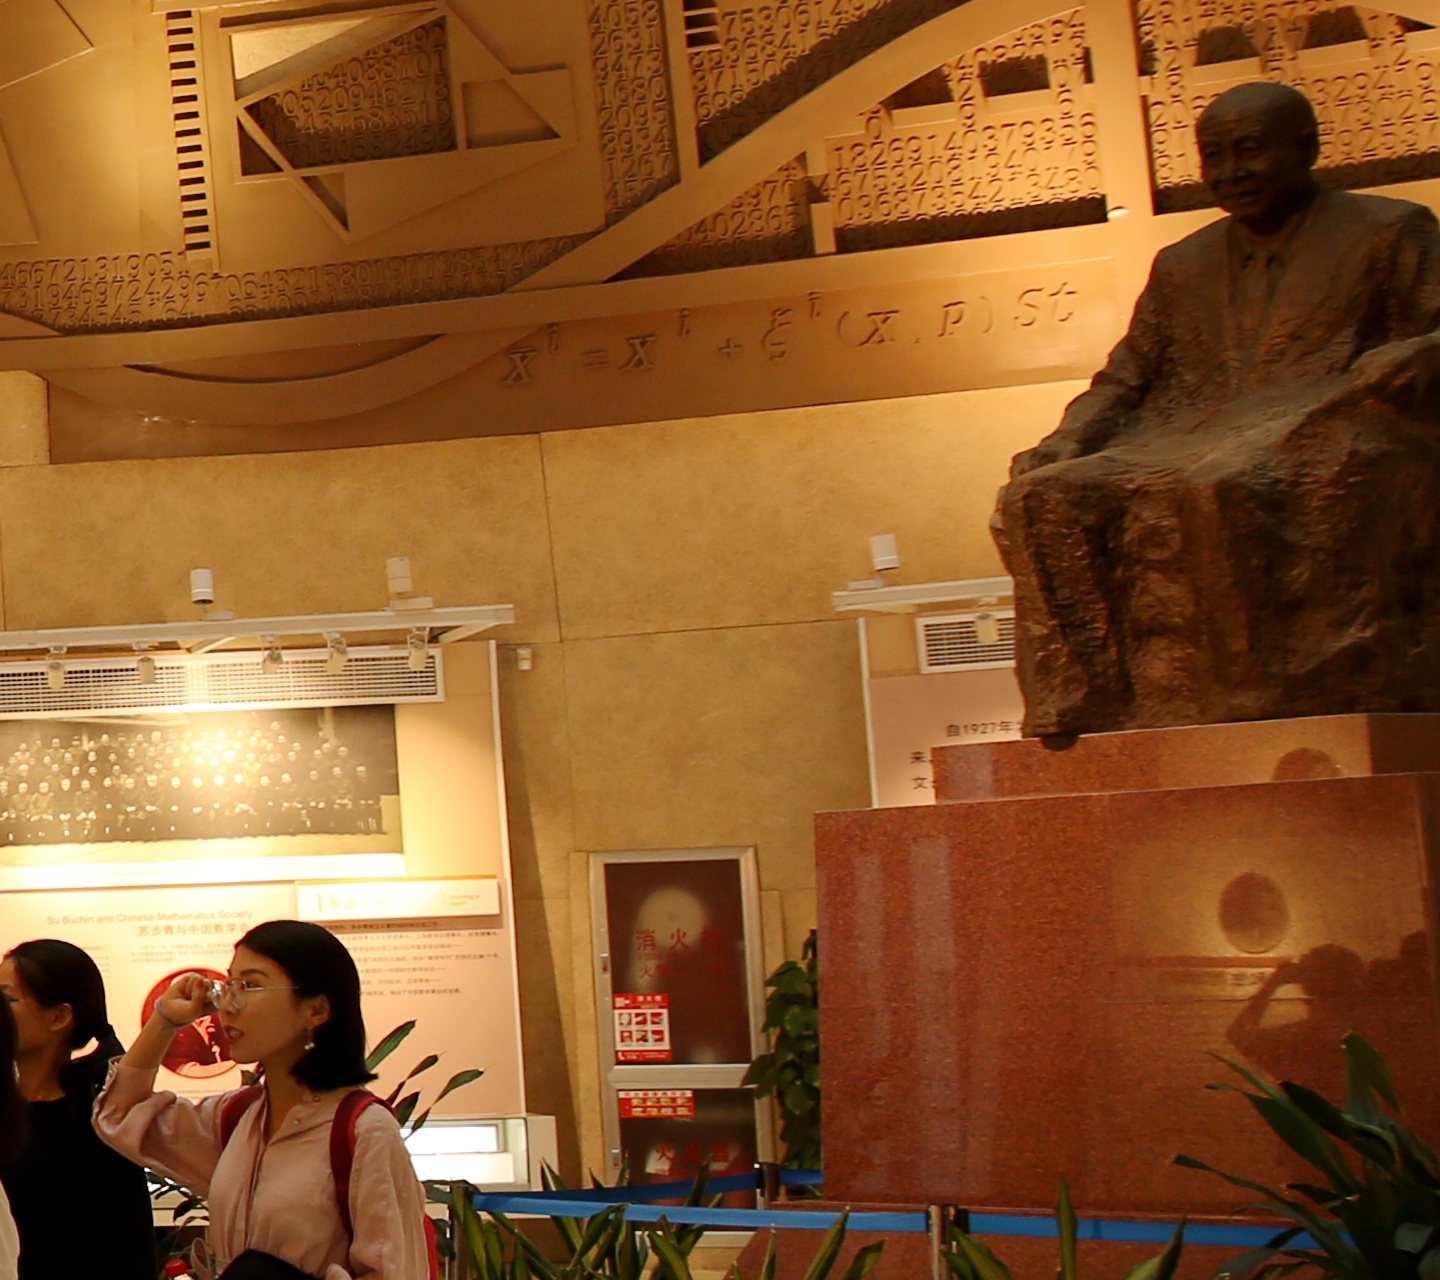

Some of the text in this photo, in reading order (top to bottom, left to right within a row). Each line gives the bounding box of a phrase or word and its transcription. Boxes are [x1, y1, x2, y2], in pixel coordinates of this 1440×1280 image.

[95, 914, 113, 924] and
[137, 922, 252, 938] 苏步青与中国数学会
